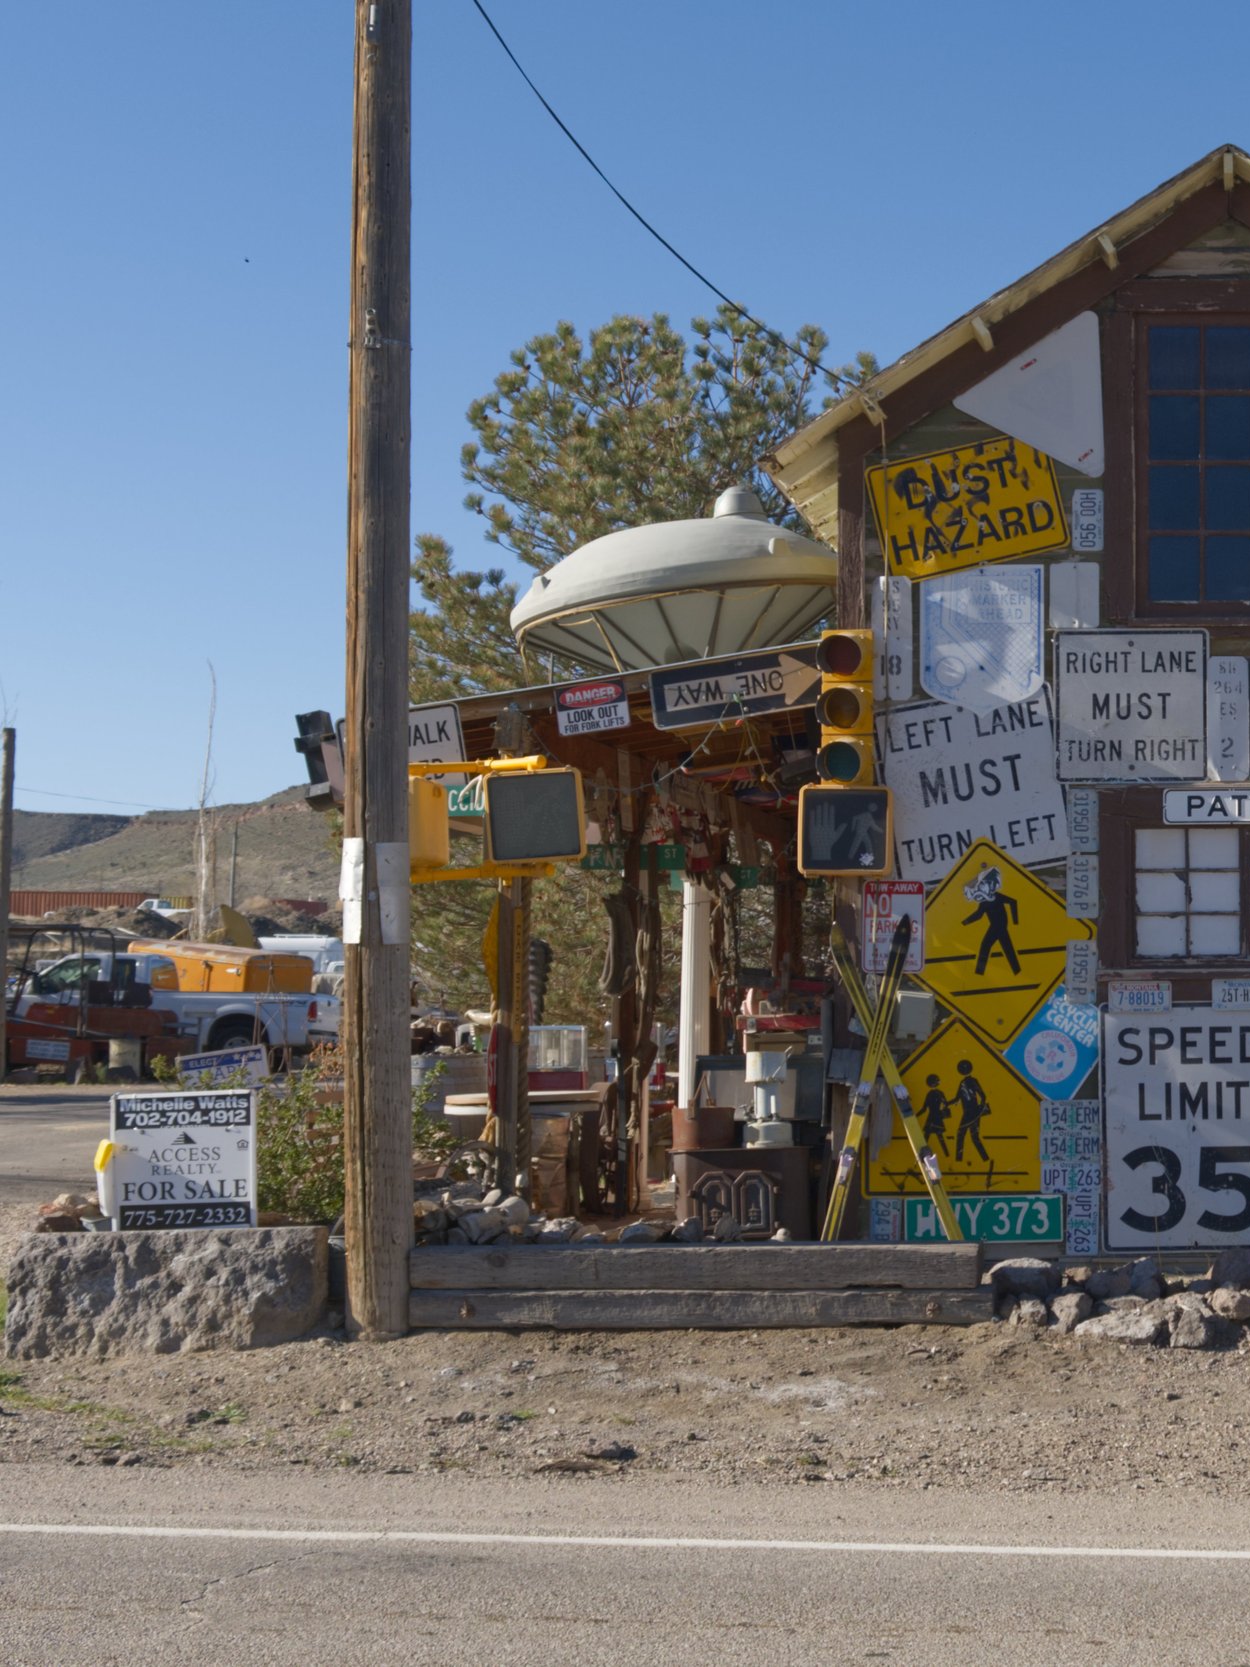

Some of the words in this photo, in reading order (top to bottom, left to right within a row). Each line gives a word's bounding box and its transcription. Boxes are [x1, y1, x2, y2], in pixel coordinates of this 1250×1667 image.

[902, 456, 1014, 510] DUST
[890, 500, 1055, 566] HAZARD
[1066, 652, 1132, 673] RIGHT
[1141, 651, 1197, 673] LANE
[674, 680, 724, 707] WAY
[735, 670, 784, 697] ONE
[565, 686, 616, 705] DANGER
[1092, 693, 1171, 720] MUST
[564, 724, 580, 735] FOR
[603, 716, 625, 728] LIFTS
[566, 708, 595, 724] LOOK
[597, 705, 619, 719] OUT
[887, 716, 953, 753] LEFT
[974, 699, 1044, 738] LANE
[408, 720, 451, 747] ALK
[1066, 740, 1123, 762] TURN
[1135, 738, 1199, 762] RIGHT
[1221, 737, 1234, 758] 2
[919, 754, 1023, 808] MUST
[901, 829, 973, 865] TURN
[990, 813, 1057, 850] LEFT
[866, 894, 890, 915] NO
[1045, 1009, 1096, 1048] CENTER
[189, 1057, 217, 1069] ELECT
[119, 1098, 195, 1112] Michelle
[198, 1096, 249, 1109] Watts
[1138, 1081, 1250, 1121] LIMIT
[124, 1109, 247, 1126] 702-704-1912
[148, 1147, 221, 1163] ACCESS
[151, 1164, 217, 1176] REALTY
[1044, 1169, 1068, 1186] UPT
[1077, 1168, 1101, 1186] 263
[122, 1181, 176, 1201] FOR
[185, 1178, 248, 1200] SALE
[124, 1207, 247, 1226] 775-727-2332
[992, 1201, 1049, 1235] 373
